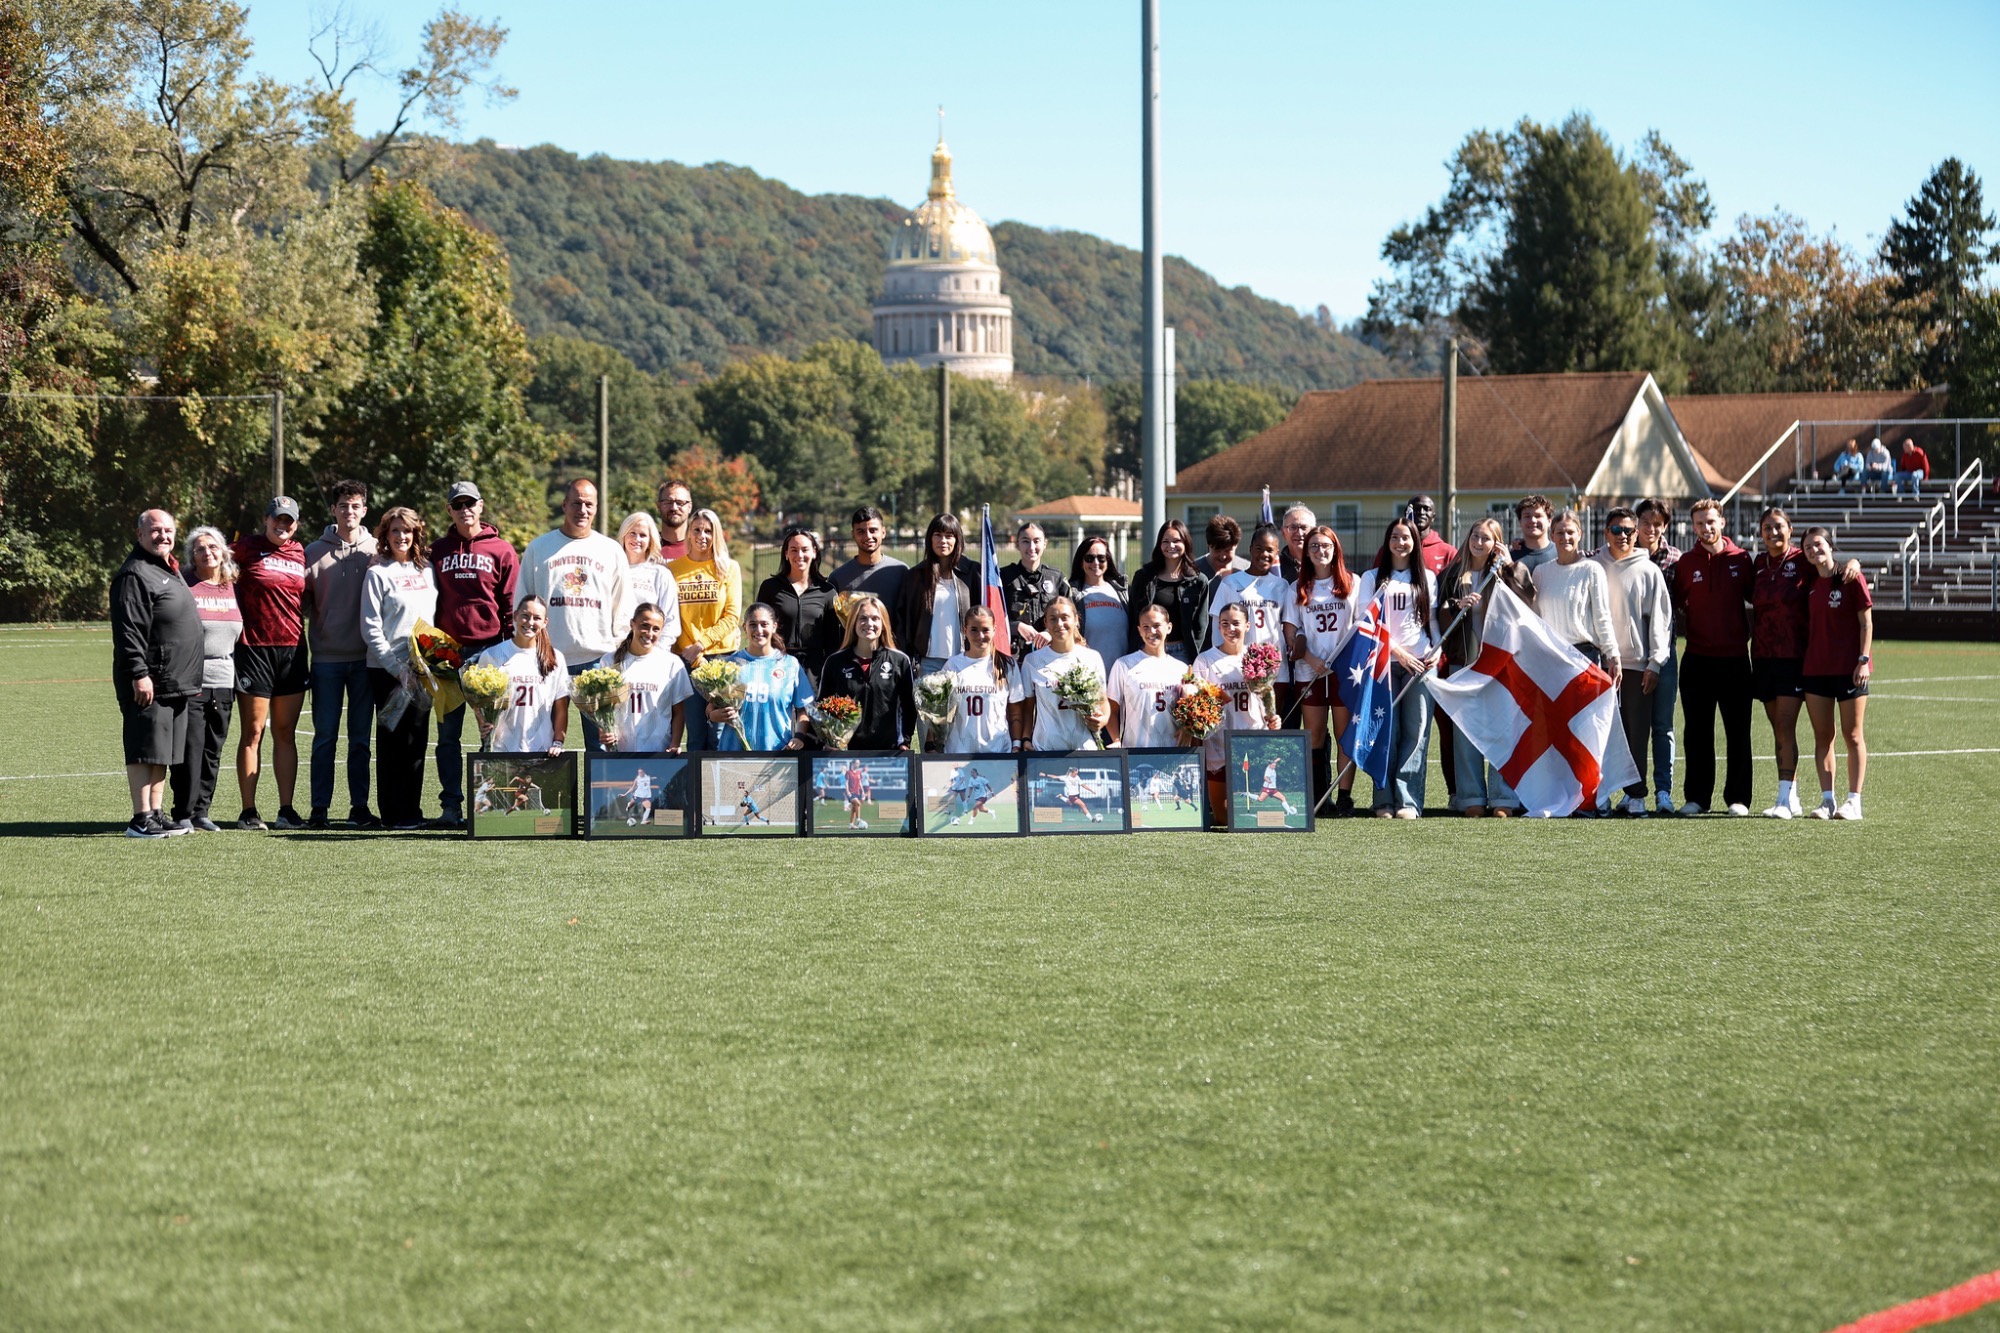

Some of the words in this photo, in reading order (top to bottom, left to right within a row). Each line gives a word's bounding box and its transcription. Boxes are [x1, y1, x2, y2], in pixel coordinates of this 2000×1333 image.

[441, 553, 493, 574] EAGLES
[549, 555, 593, 570] UNIVERSITY
[677, 591, 719, 601] SOCCER
[678, 583, 719, 593] WOMEN'S
[550, 597, 602, 609] CHARLESTON
[1239, 600, 1279, 609] CHARLESTON
[1306, 602, 1346, 614] CHARLESTON
[1393, 592, 1406, 611] 10
[1254, 609, 1265, 629] 3
[1315, 612, 1338, 633] 32
[512, 675, 546, 685] ARLESTON
[515, 685, 534, 706] 21
[630, 692, 642, 713] 11
[1155, 691, 1167, 712] 5
[1233, 691, 1249, 712] 18
[966, 695, 984, 717] 10
